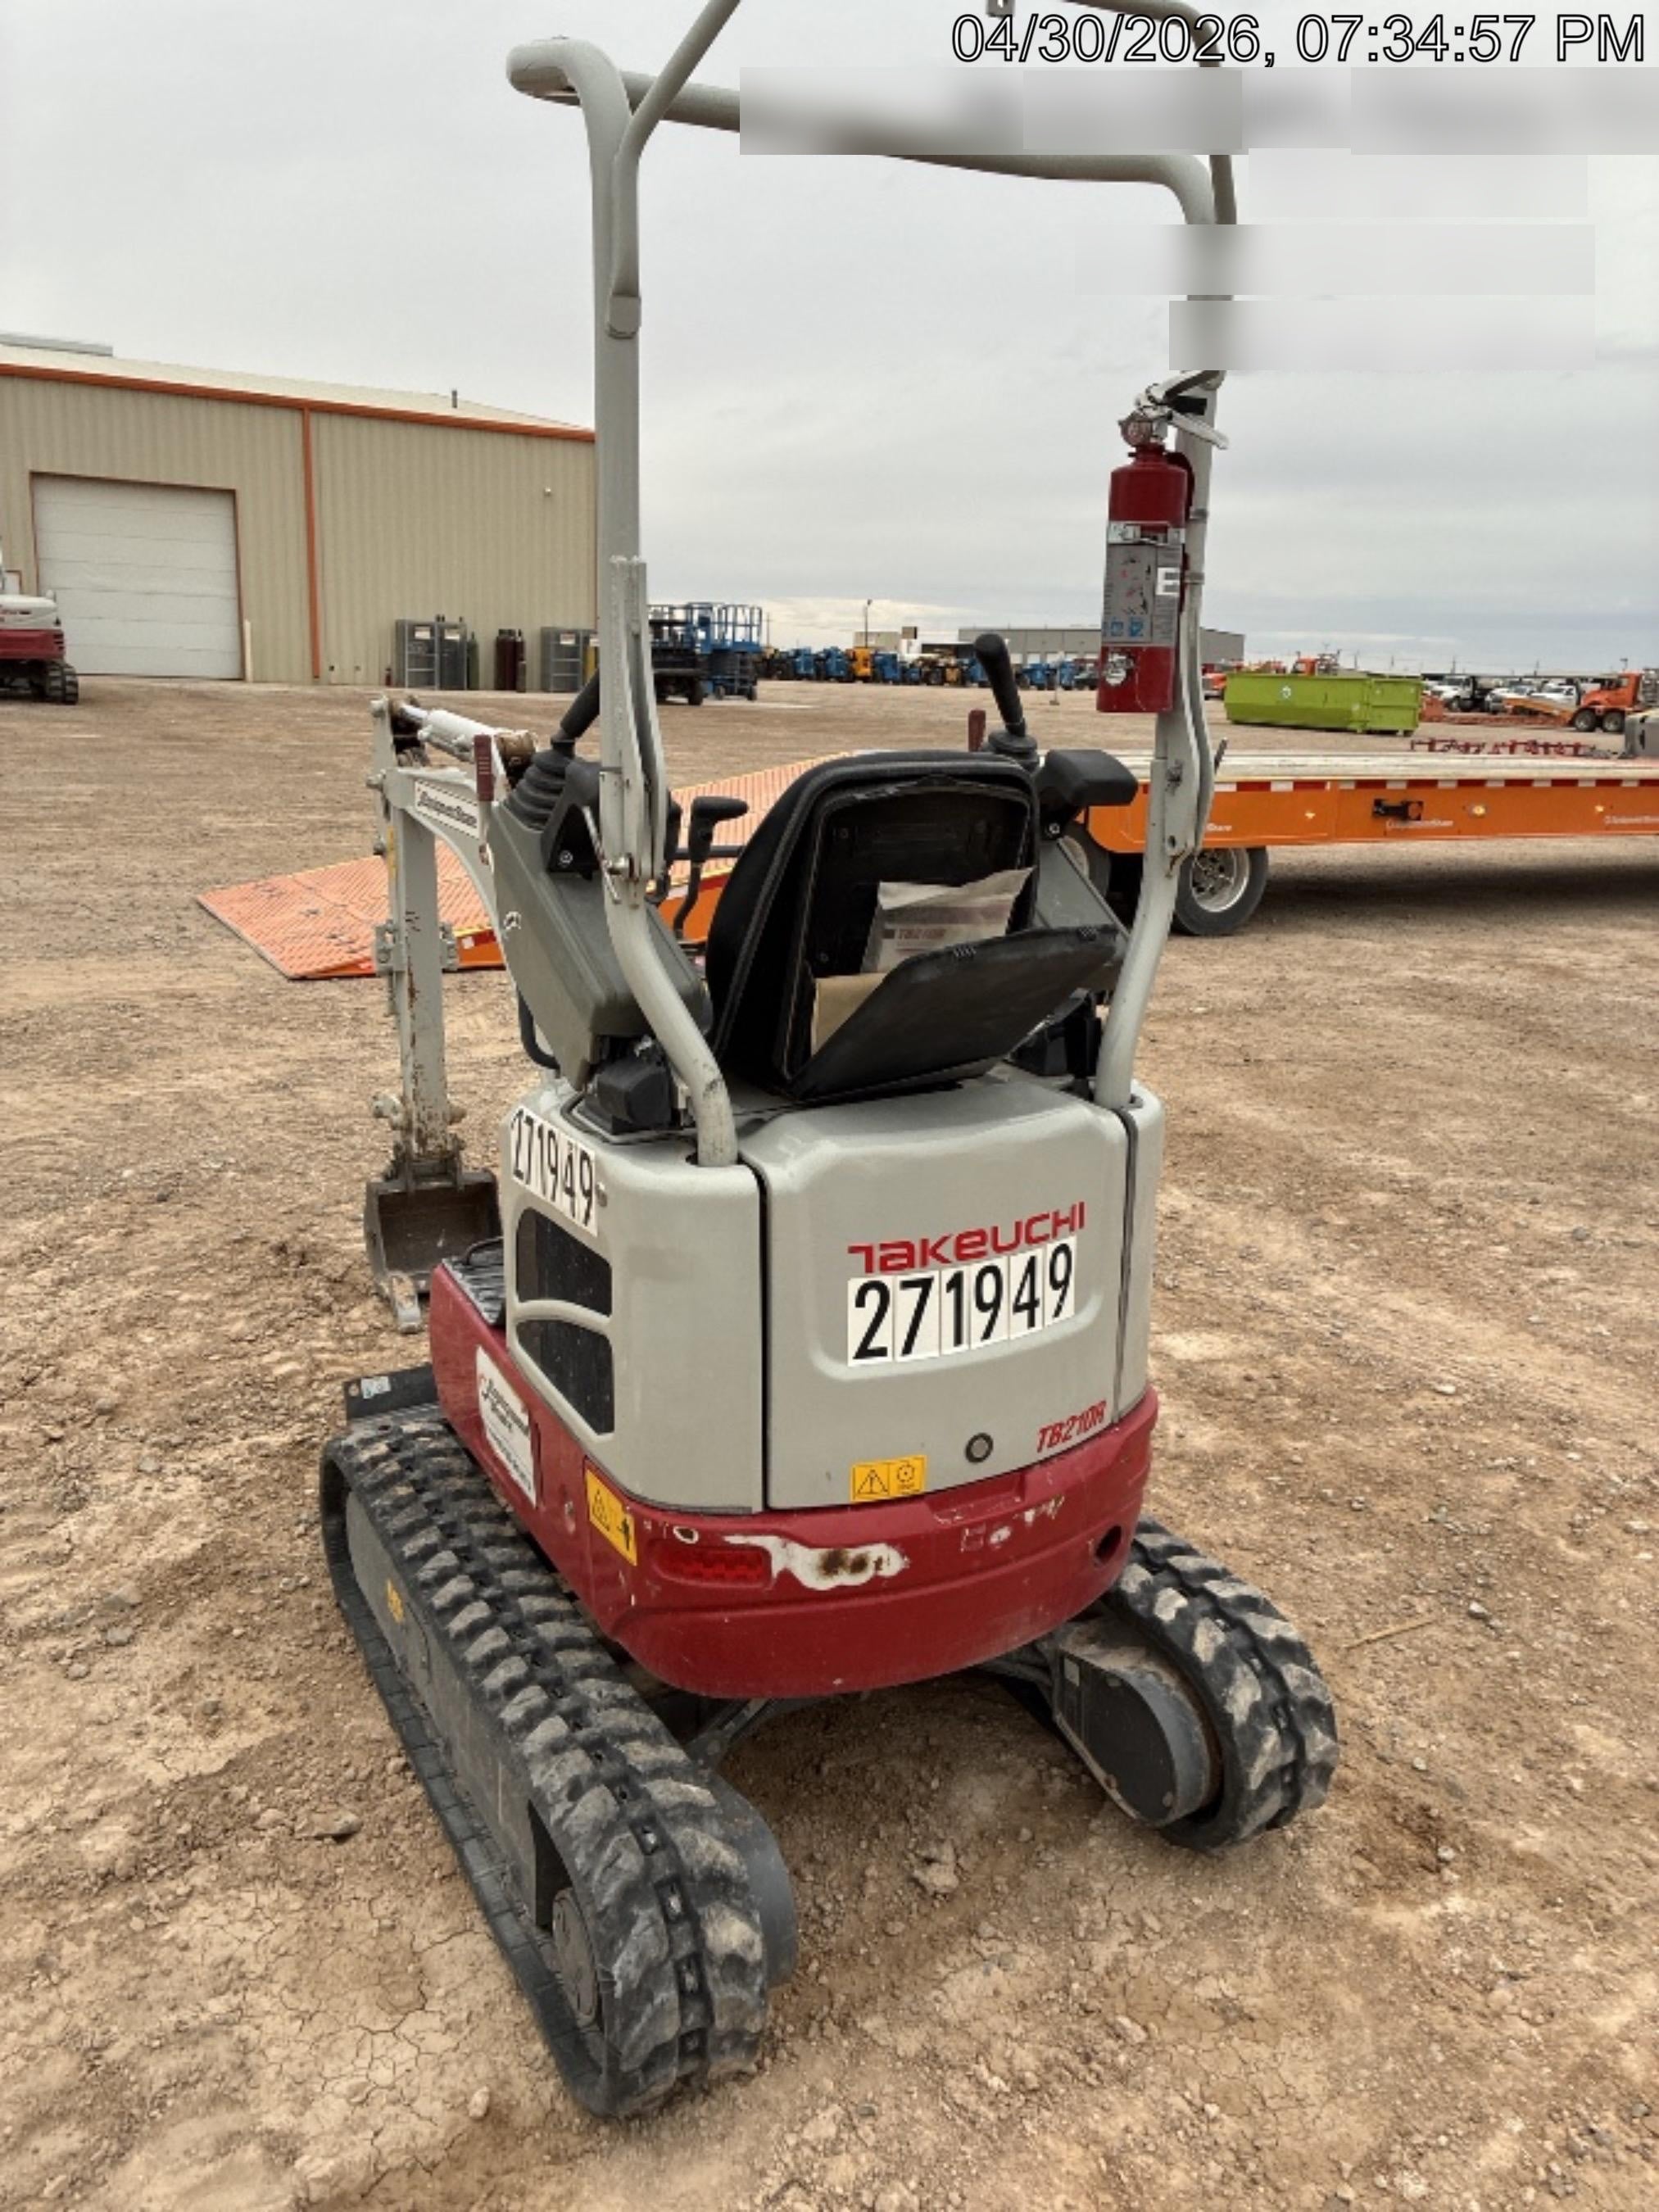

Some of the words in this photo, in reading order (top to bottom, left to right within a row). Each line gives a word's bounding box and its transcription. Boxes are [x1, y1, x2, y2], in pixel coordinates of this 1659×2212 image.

[510, 1108, 593, 1227] 271949
[853, 1243, 1073, 1360] 271949
[1036, 1398, 1107, 1453] TB210R
